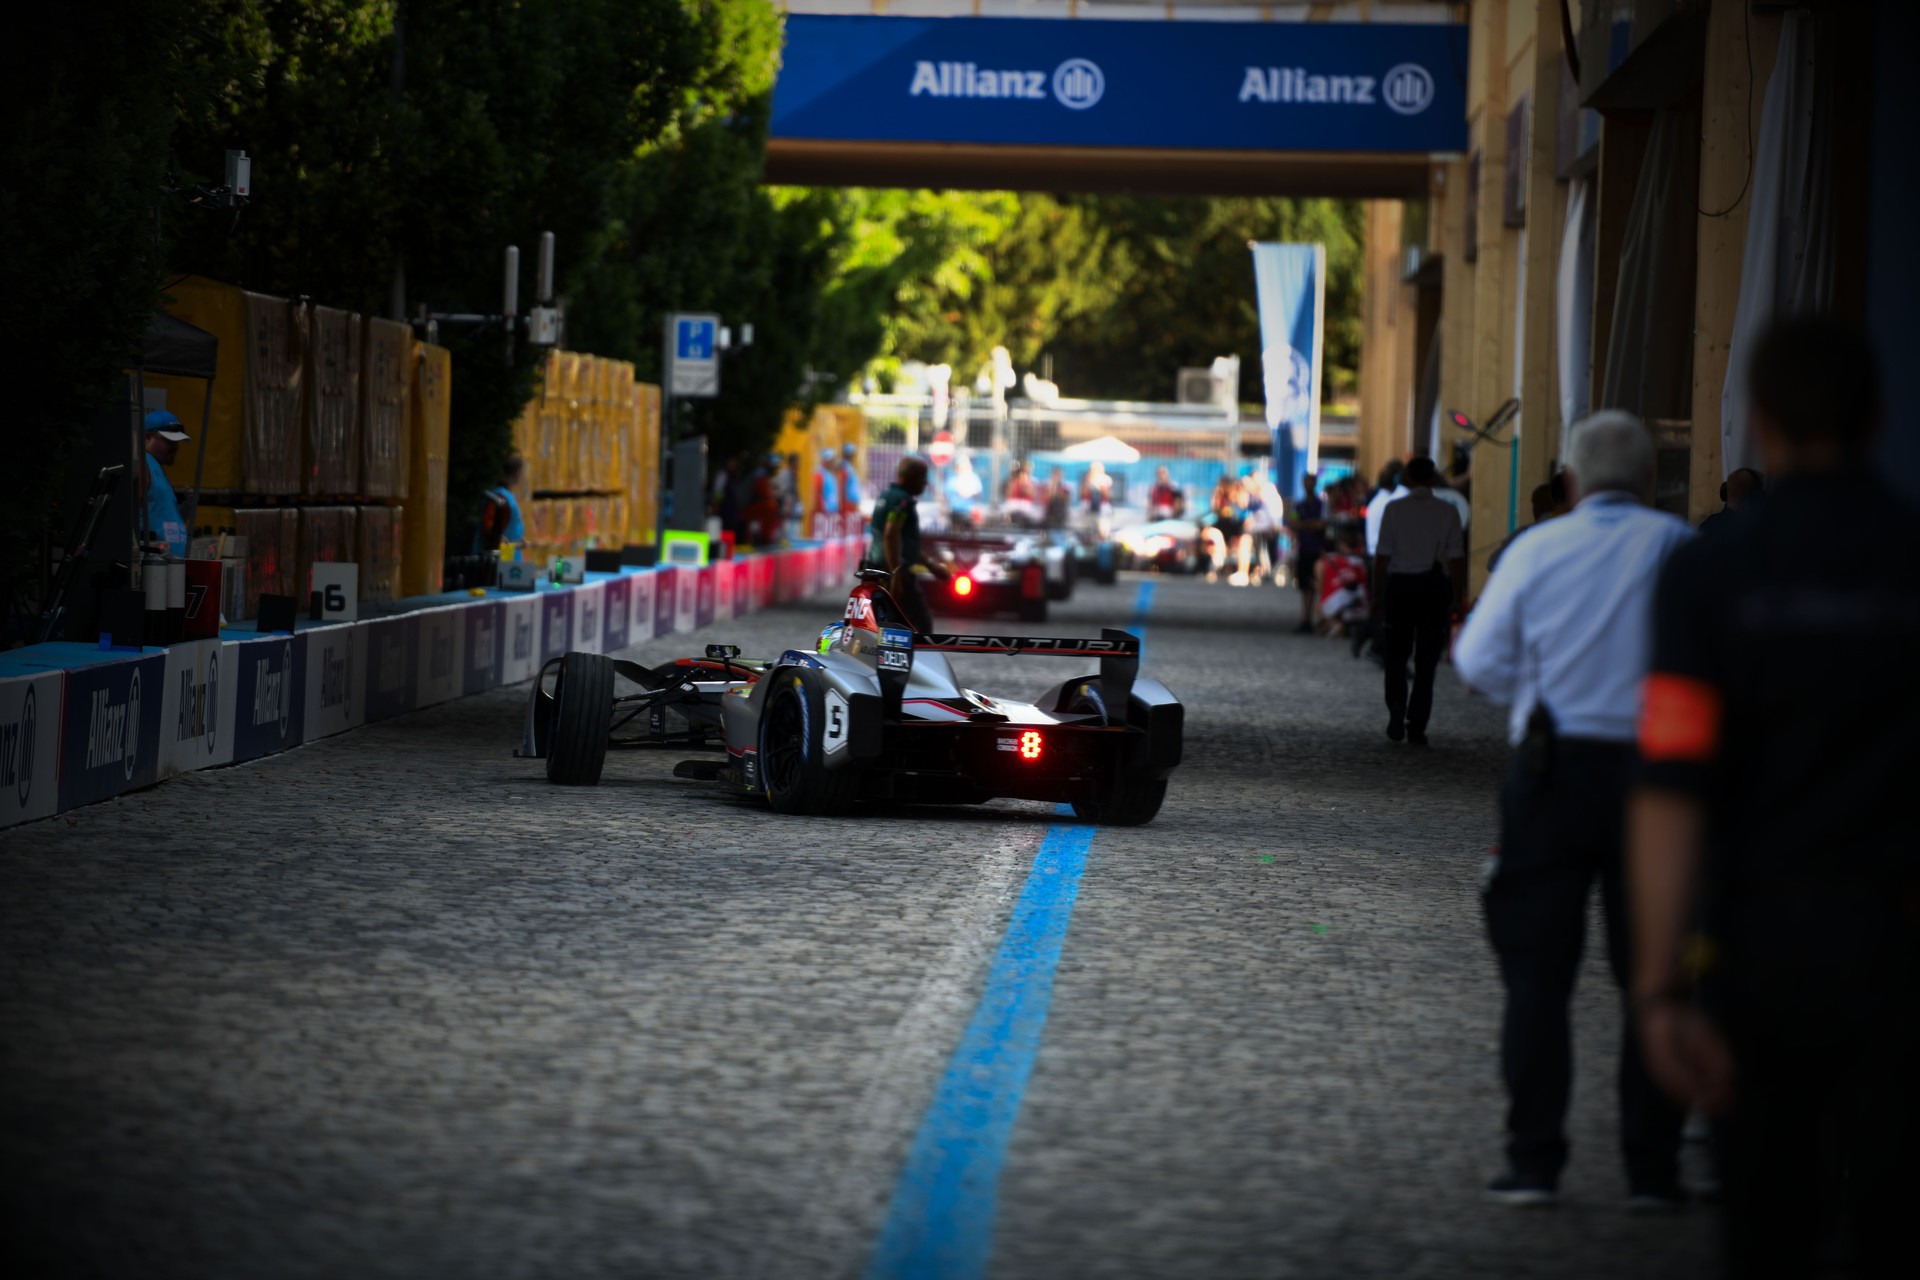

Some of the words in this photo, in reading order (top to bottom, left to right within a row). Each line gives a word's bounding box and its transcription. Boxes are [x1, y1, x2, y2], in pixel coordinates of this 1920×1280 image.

[910, 60, 1047, 99] Allianz
[1239, 66, 1376, 104] Allianz
[184, 585, 209, 619] 7
[324, 583, 345, 612] 6
[923, 635, 1126, 652] VENTURI
[176, 667, 207, 743] Allianz
[252, 658, 281, 727] Allianz
[85, 687, 127, 770] Allianz
[828, 705, 844, 740] 5
[1020, 731, 1043, 759] 8
